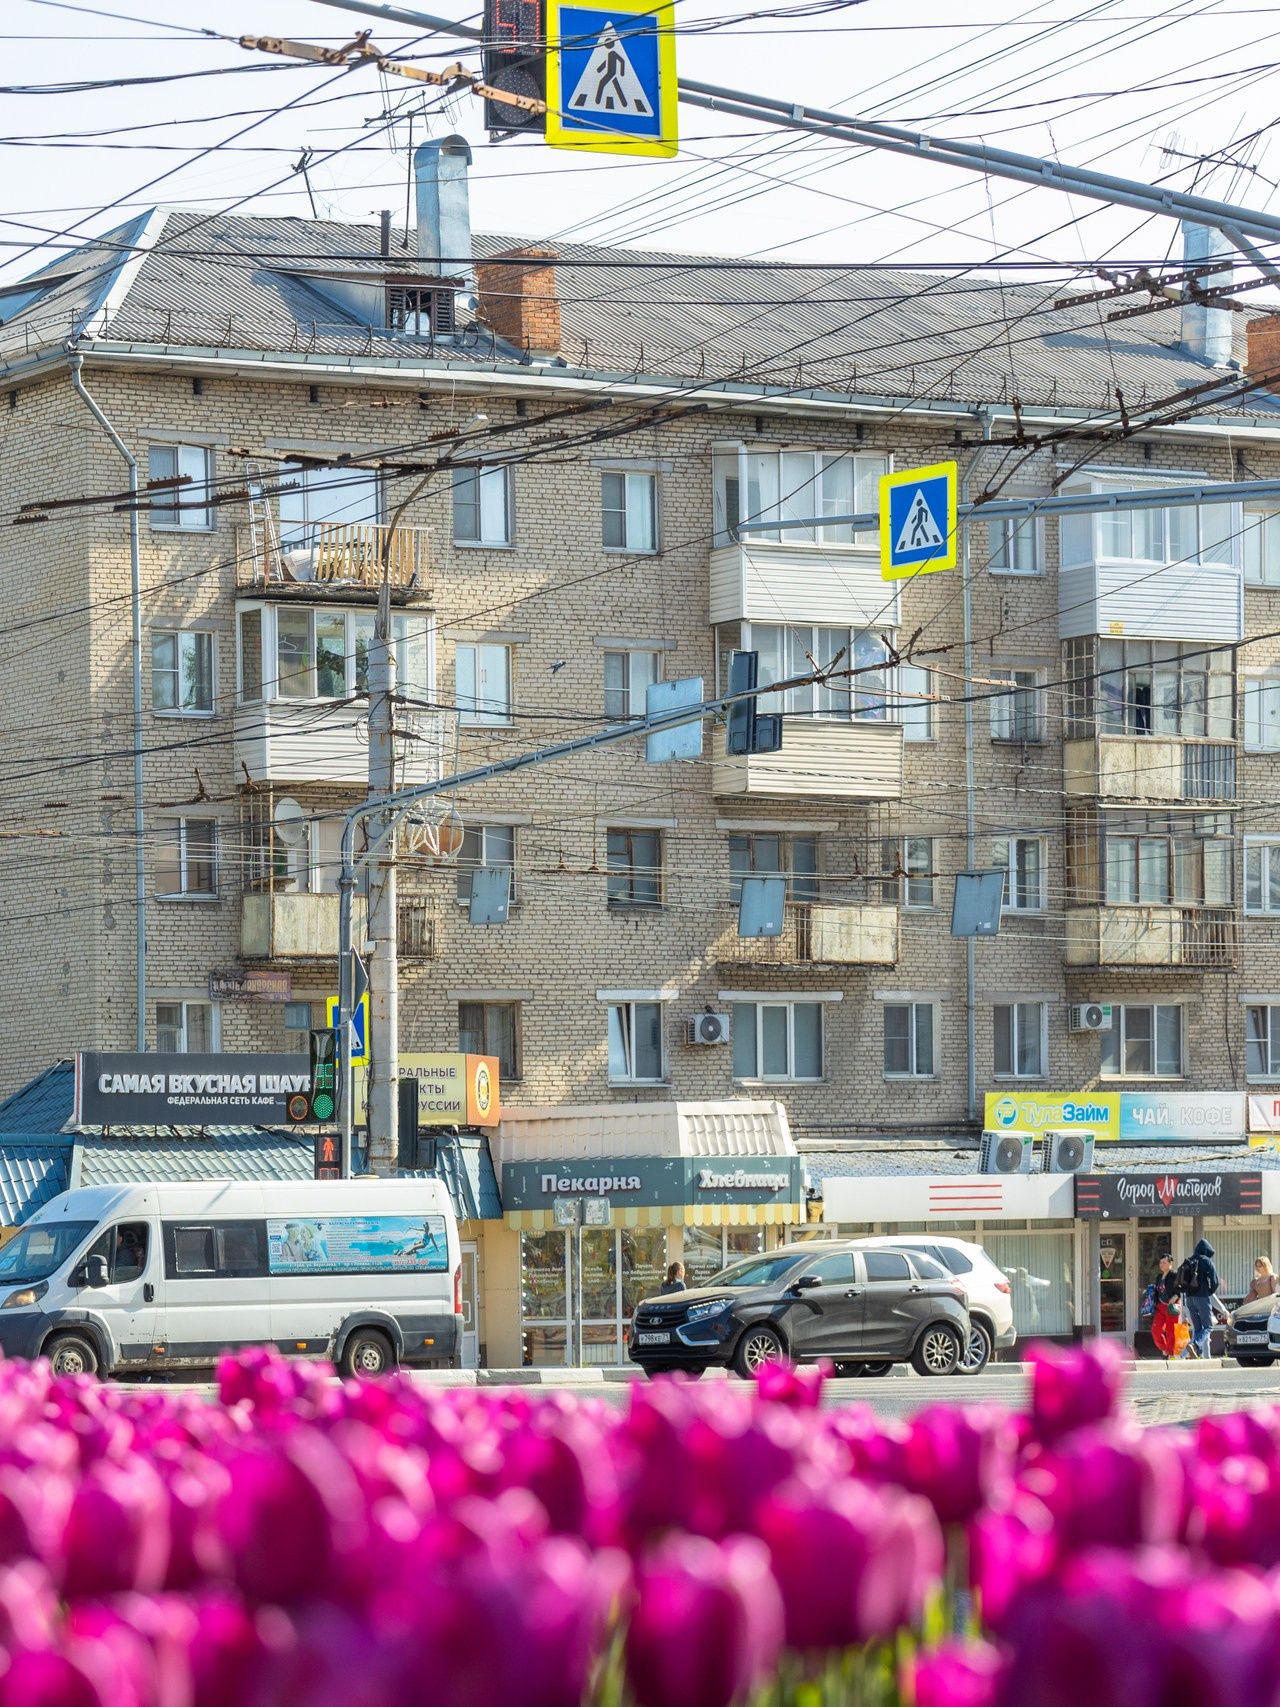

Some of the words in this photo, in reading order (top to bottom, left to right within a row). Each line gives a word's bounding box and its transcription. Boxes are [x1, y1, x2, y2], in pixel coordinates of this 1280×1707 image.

[98, 1073, 166, 1094] САМАЯ
[168, 1073, 257, 1094] ВКУСНАЯ
[167, 1096, 228, 1105] ФЕДЕРАЛЬНАЯ
[230, 1096, 250, 1105] СЕТЬ
[251, 1096, 274, 1105] КАФЕ
[1021, 1103, 1109, 1125] ТулаЗайм
[1132, 1103, 1175, 1127] ЧАЙ,
[1180, 1107, 1233, 1125] КОФЕ
[541, 1174, 642, 1195] Пекарня
[699, 1169, 790, 1191] Хлебница
[1117, 1177, 1155, 1204] Город
[1158, 1175, 1222, 1202] Мастеров
